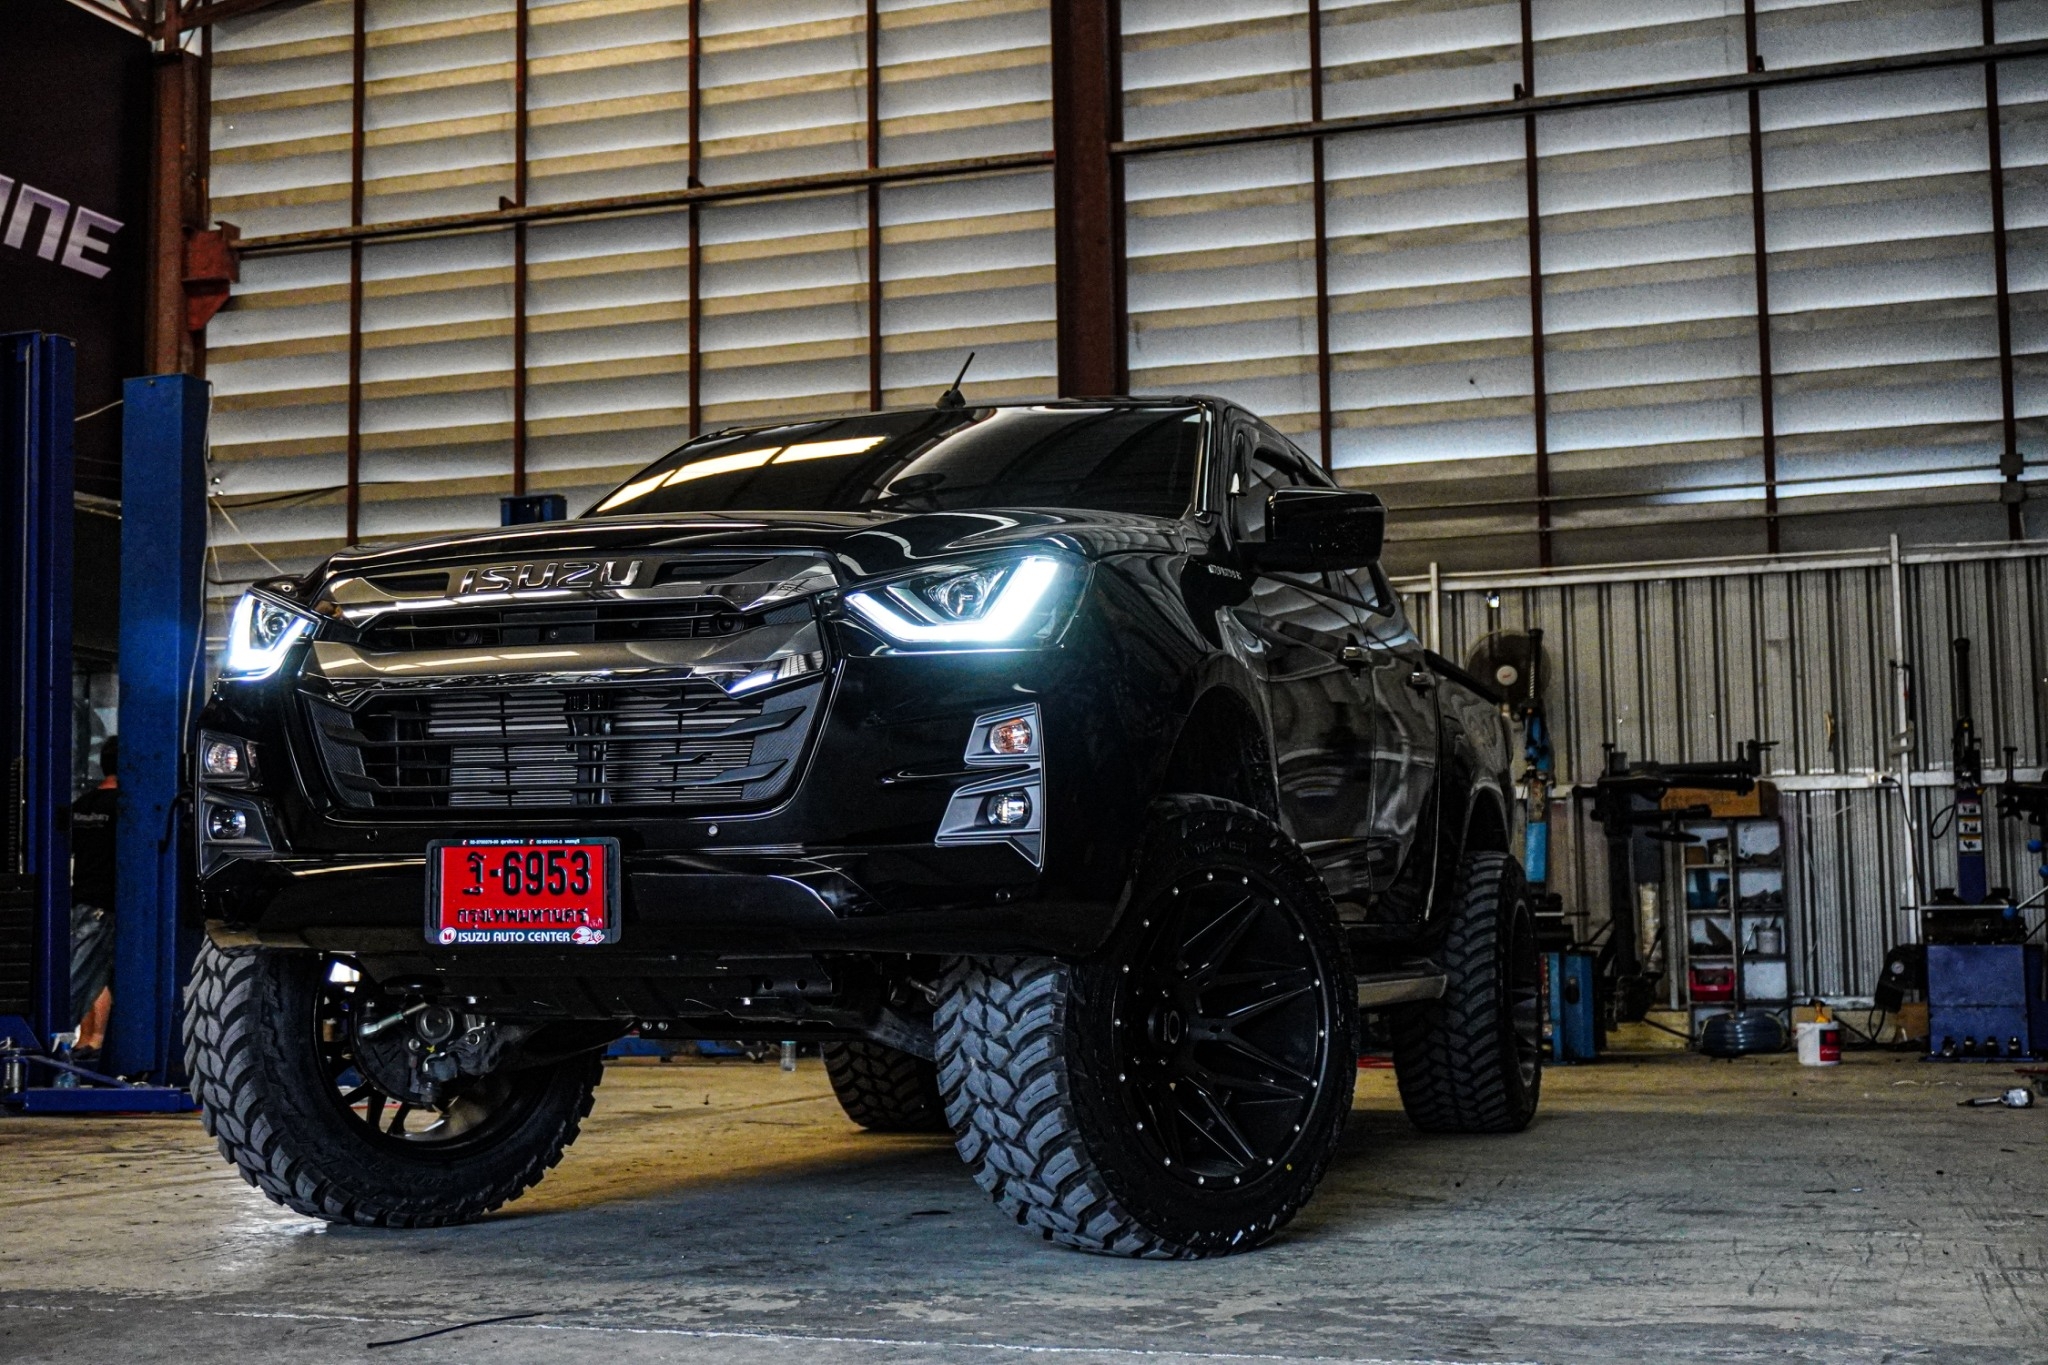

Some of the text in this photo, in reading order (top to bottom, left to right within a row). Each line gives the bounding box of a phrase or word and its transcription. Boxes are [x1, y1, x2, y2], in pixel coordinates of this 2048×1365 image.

[460, 560, 643, 594] ISUZU
[457, 907, 588, 929] กรุงเทพมหานคร
[458, 931, 570, 943] ISUZU AUTO CENTER
